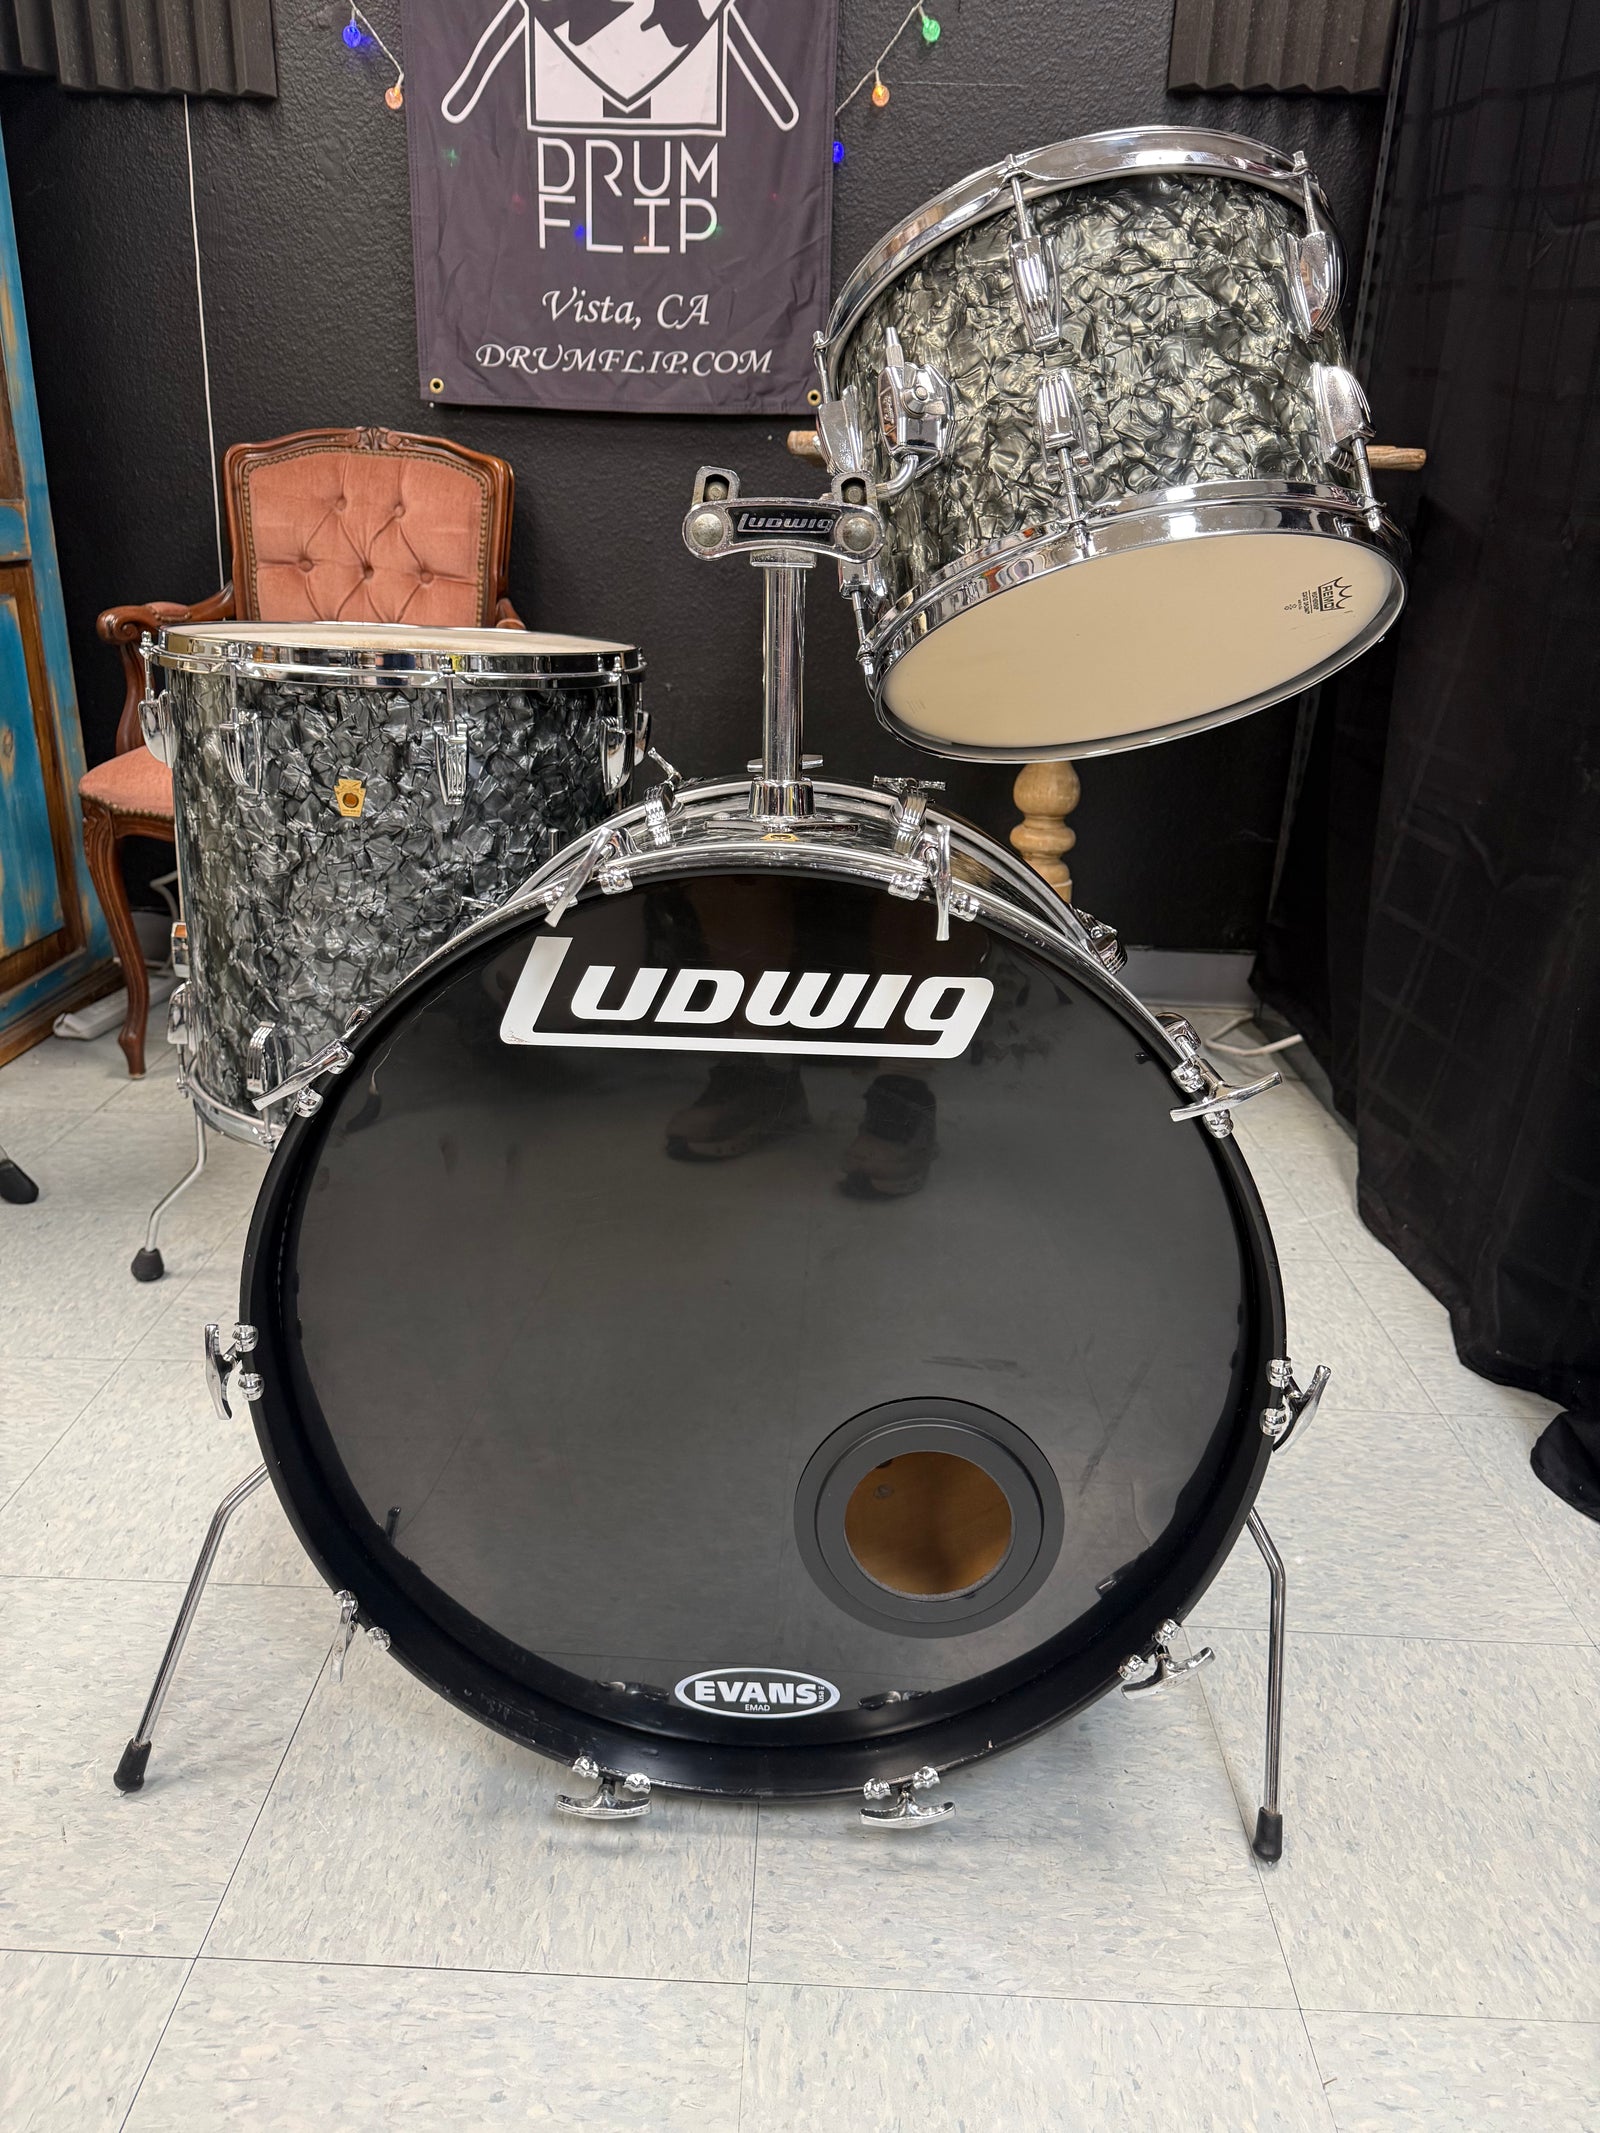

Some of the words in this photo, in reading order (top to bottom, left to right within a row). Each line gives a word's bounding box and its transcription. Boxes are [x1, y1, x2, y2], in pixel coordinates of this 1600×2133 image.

[537, 136, 718, 198] DRUM
[538, 194, 718, 253] FLIP
[542, 286, 642, 330] Vista,
[656, 293, 710, 330] CA
[475, 343, 773, 377] DRUMFLIP.COM
[1322, 585, 1335, 609] REMO
[694, 1680, 818, 1705] EVANS
[744, 1704, 771, 1712] EMAD
